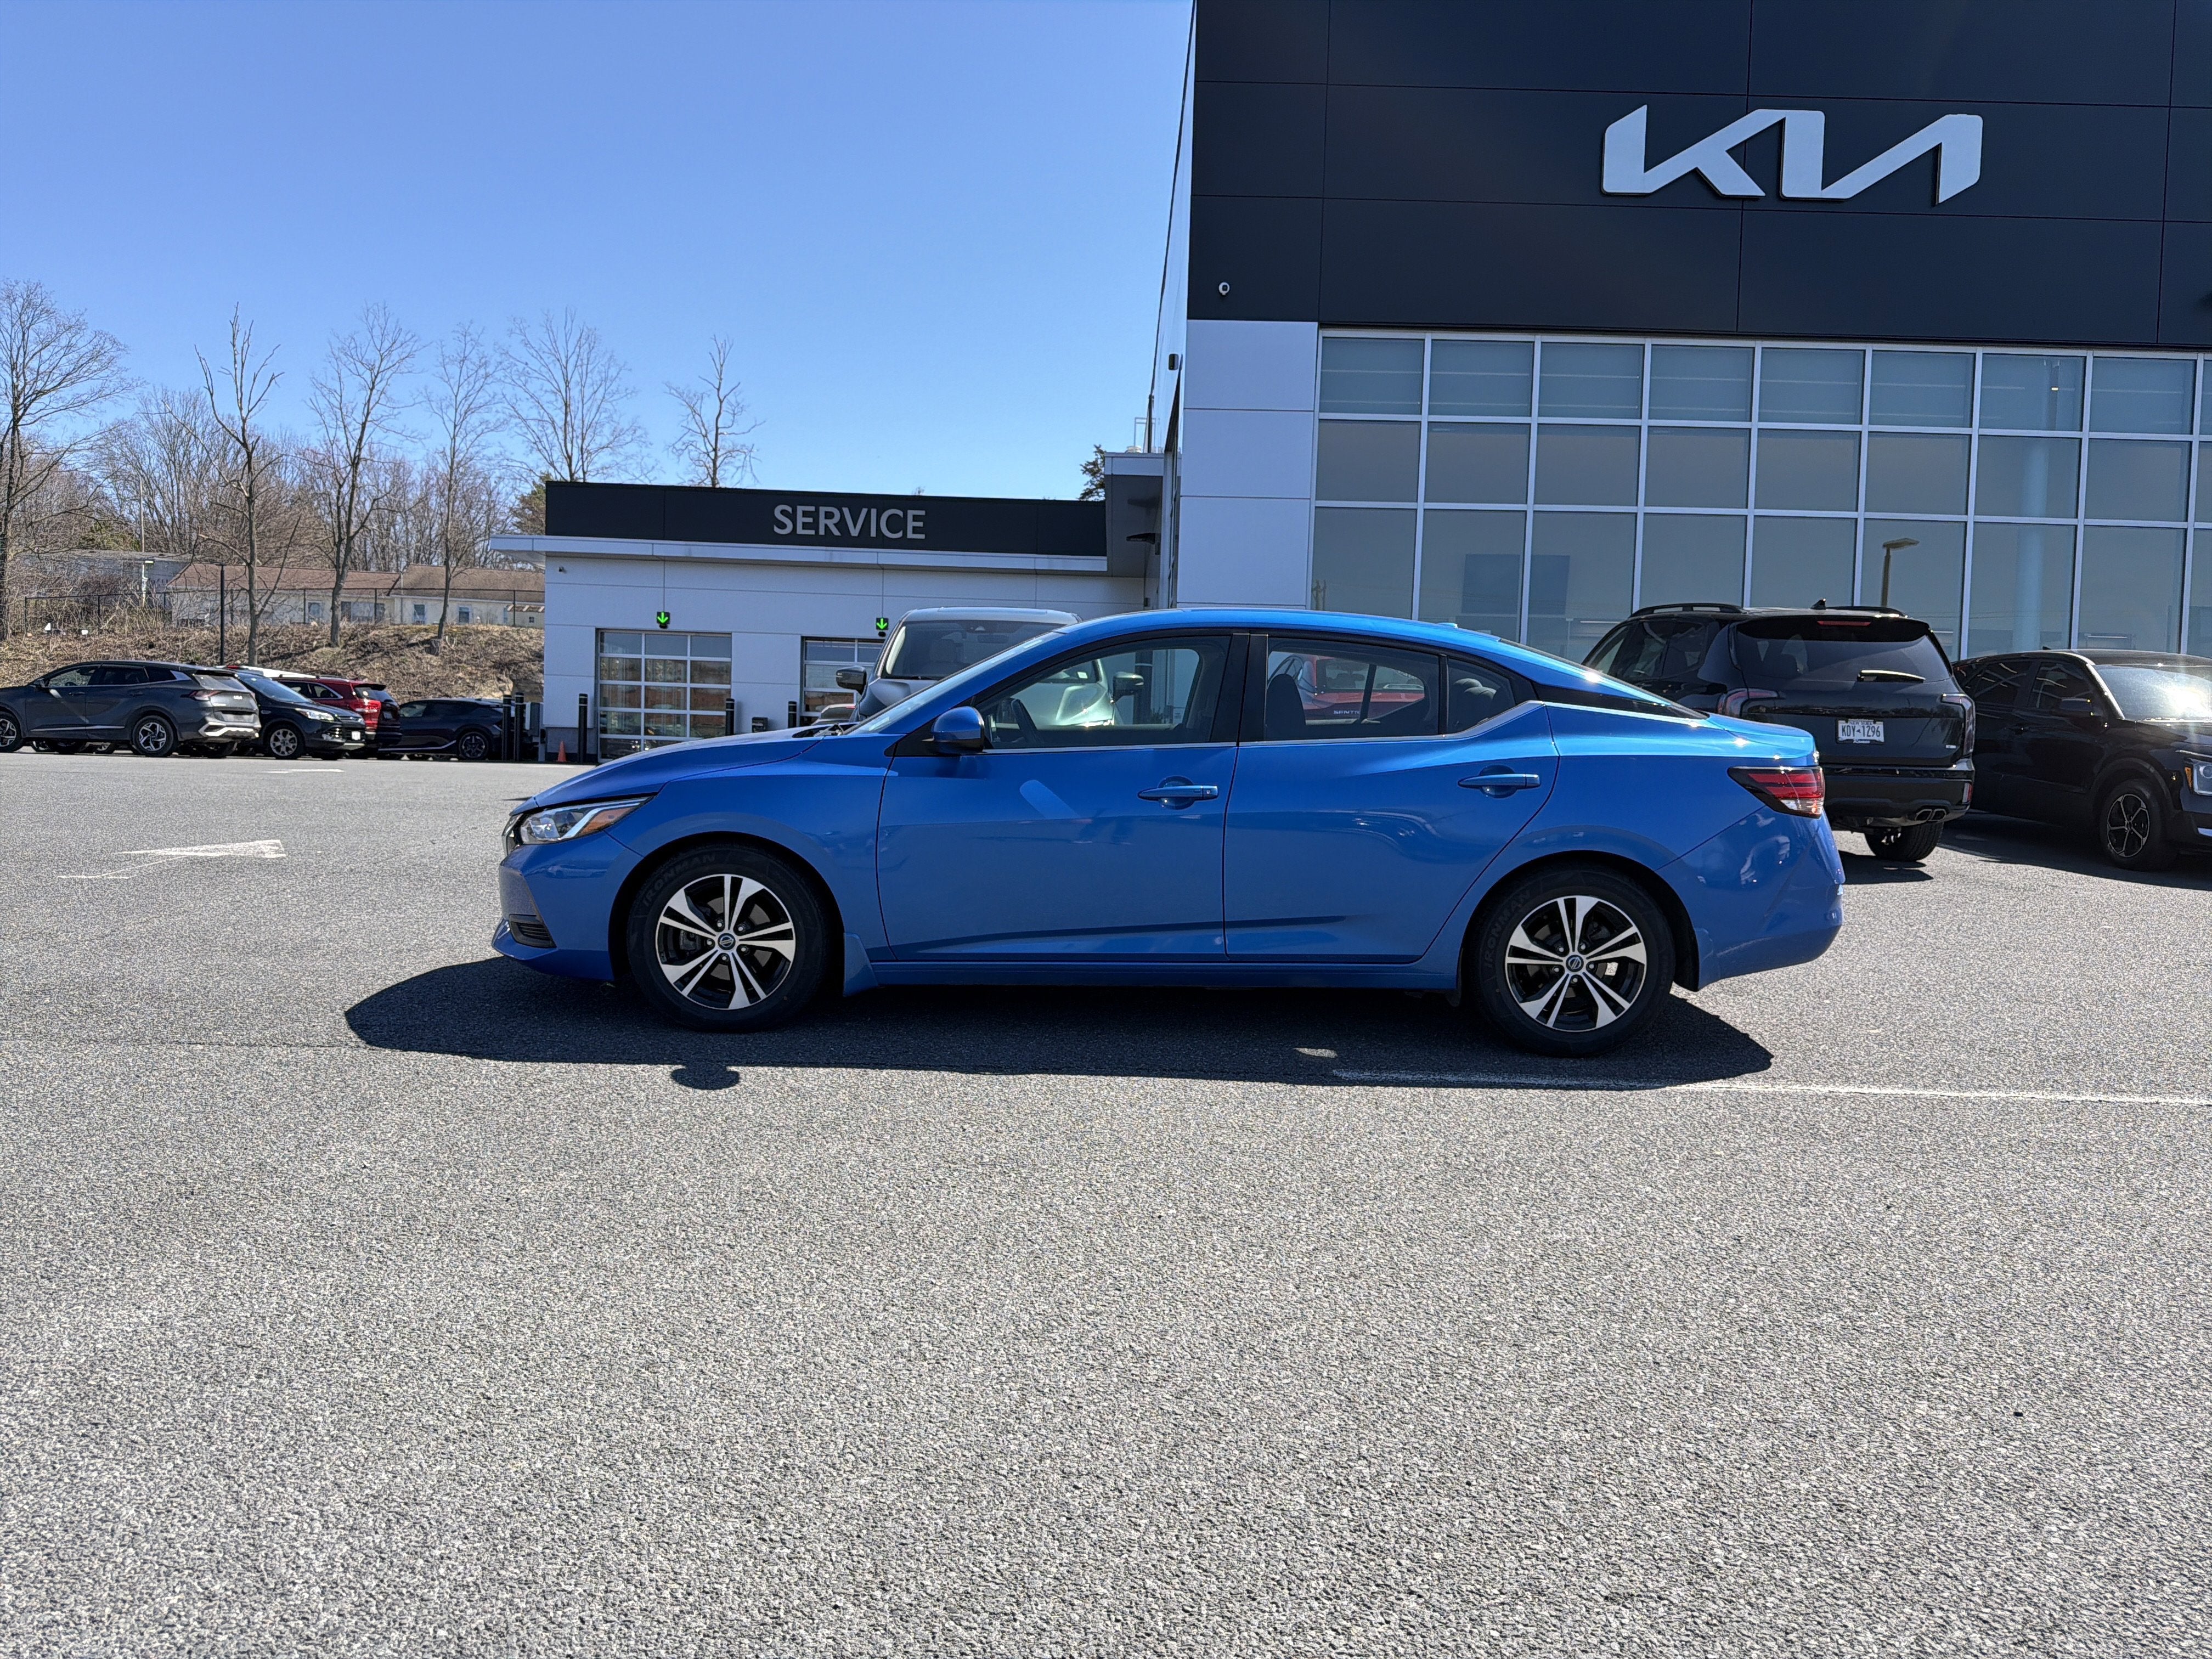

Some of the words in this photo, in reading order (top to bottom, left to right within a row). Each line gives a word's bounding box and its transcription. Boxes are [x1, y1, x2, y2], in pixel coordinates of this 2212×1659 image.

[1603, 104, 1983, 204] KIA
[774, 504, 926, 539] SERVICE
[1842, 725, 1856, 737] KDY
[1861, 725, 1881, 737] 1296
[643, 853, 716, 907] IRONMAN
